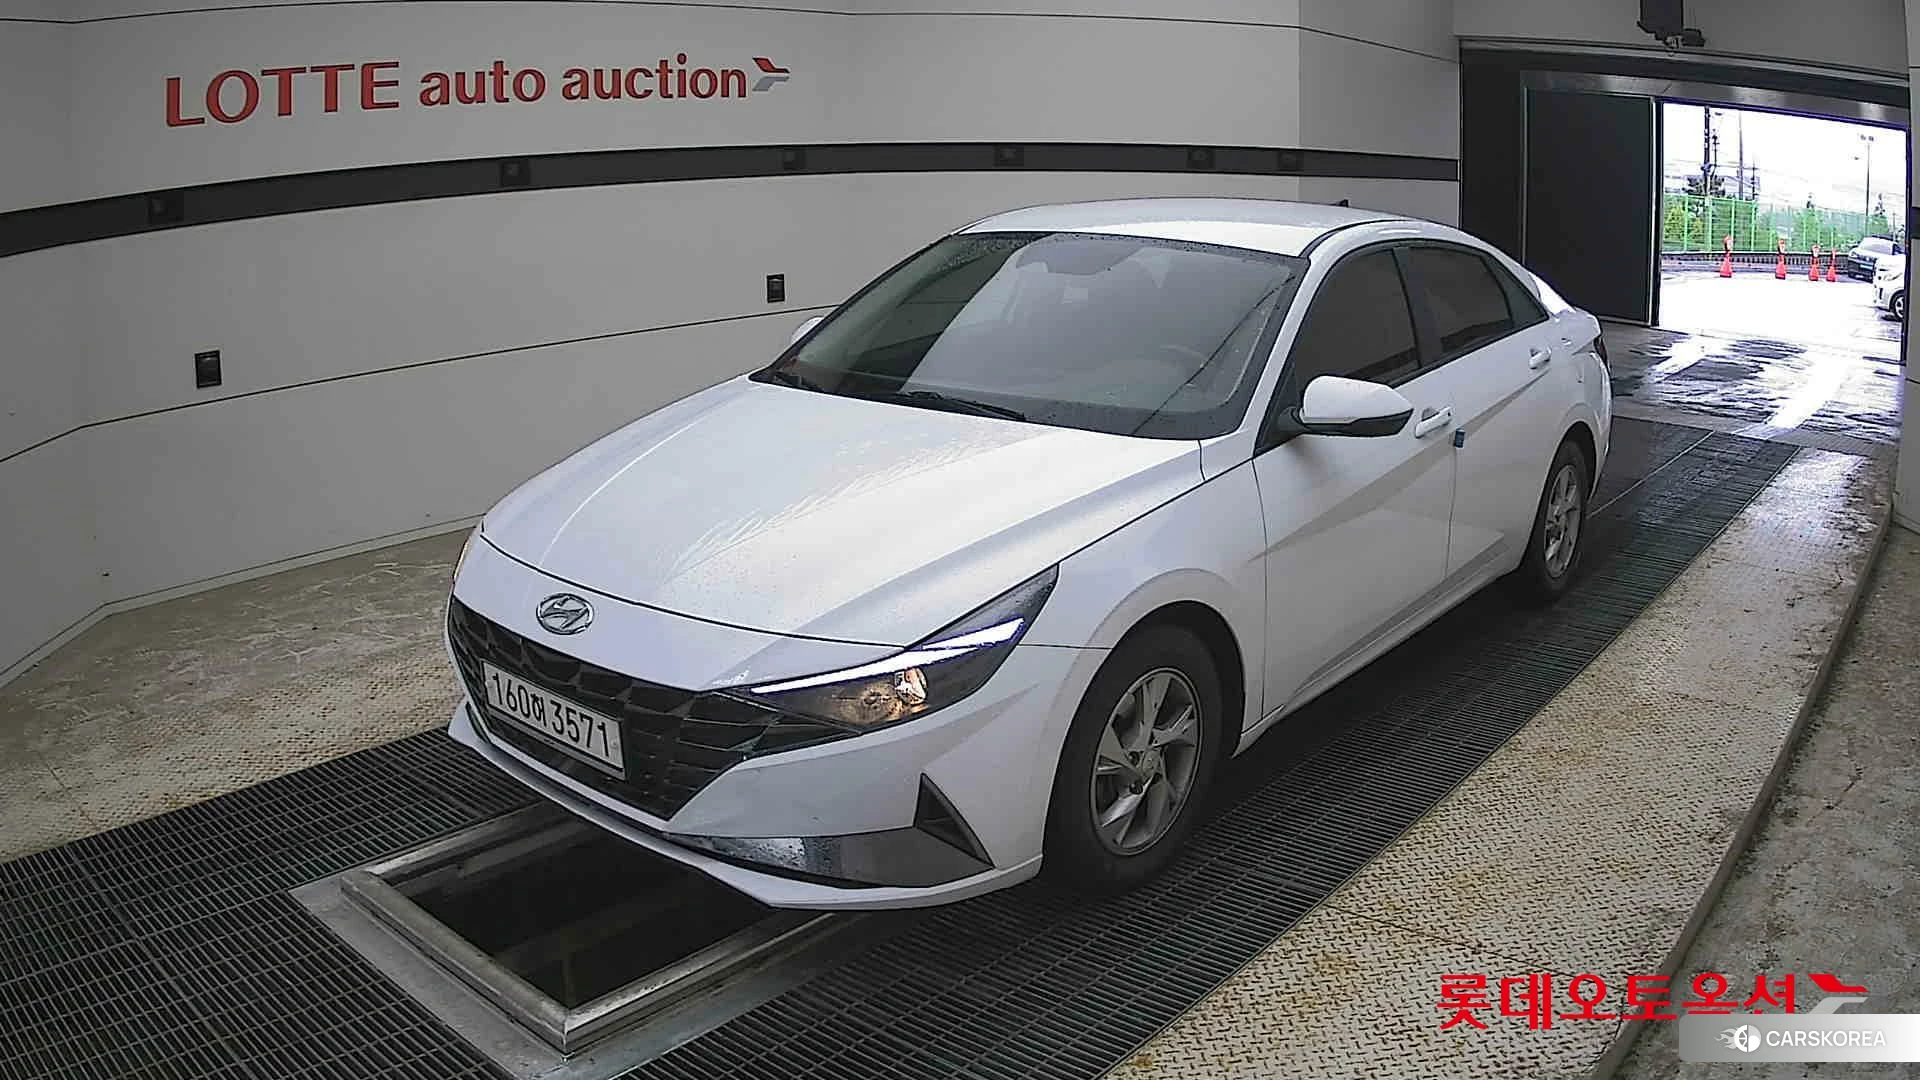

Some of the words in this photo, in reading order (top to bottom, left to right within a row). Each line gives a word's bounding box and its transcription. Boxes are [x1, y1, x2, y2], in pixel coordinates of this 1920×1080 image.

[165, 61, 400, 128] LOTTE
[418, 60, 547, 107] auto
[562, 52, 748, 101] auction
[549, 700, 610, 758] 3571
